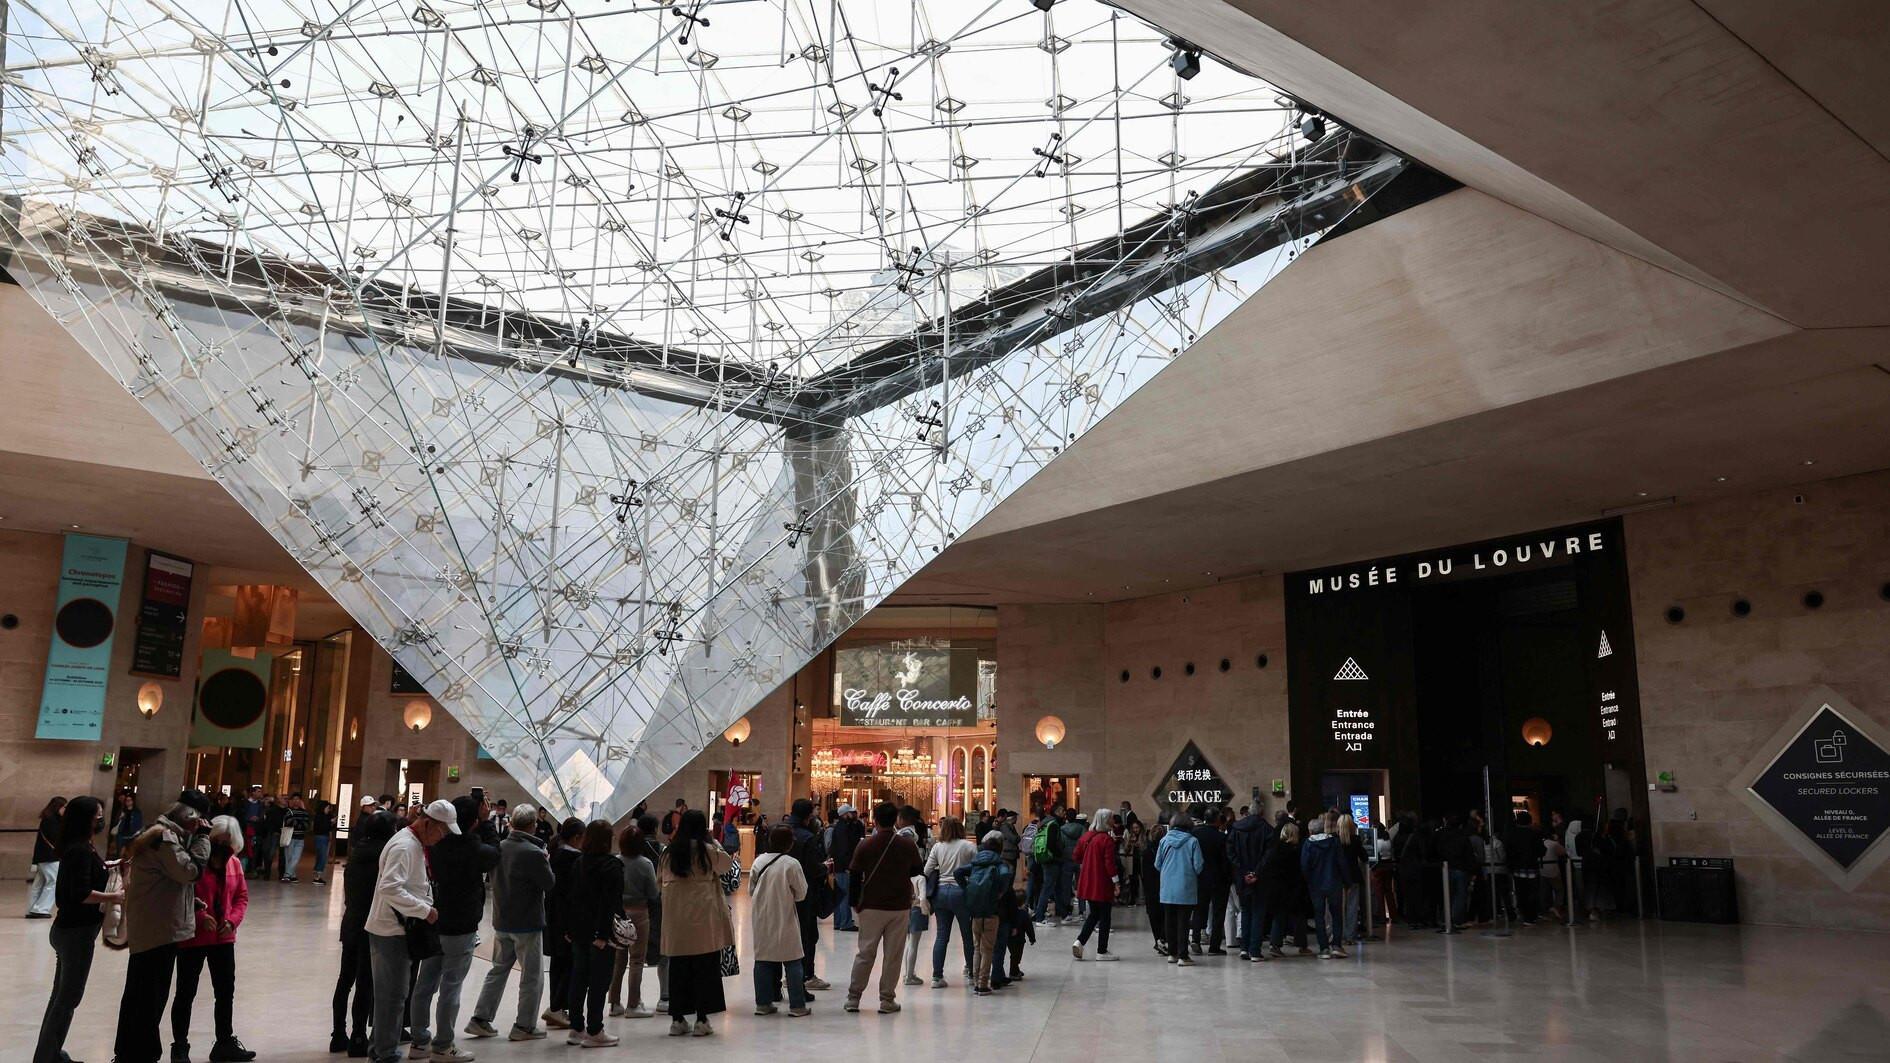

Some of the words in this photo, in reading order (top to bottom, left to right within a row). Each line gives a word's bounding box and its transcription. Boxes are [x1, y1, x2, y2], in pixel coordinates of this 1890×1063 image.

[1309, 566, 1397, 594] MUSÉE
[1417, 558, 1452, 578] DU
[1473, 532, 1603, 570] LOUVRE
[896, 688, 972, 712] Concerto
[1336, 709, 1369, 718] Entrée
[1331, 720, 1375, 729] Entrance
[1334, 731, 1373, 740] Entrada
[1345, 742, 1362, 752] 入口
[1177, 769, 1211, 781] 货币兑换
[1783, 772, 1833, 780] CONSIGNES
[1168, 790, 1222, 803] CHANGE
